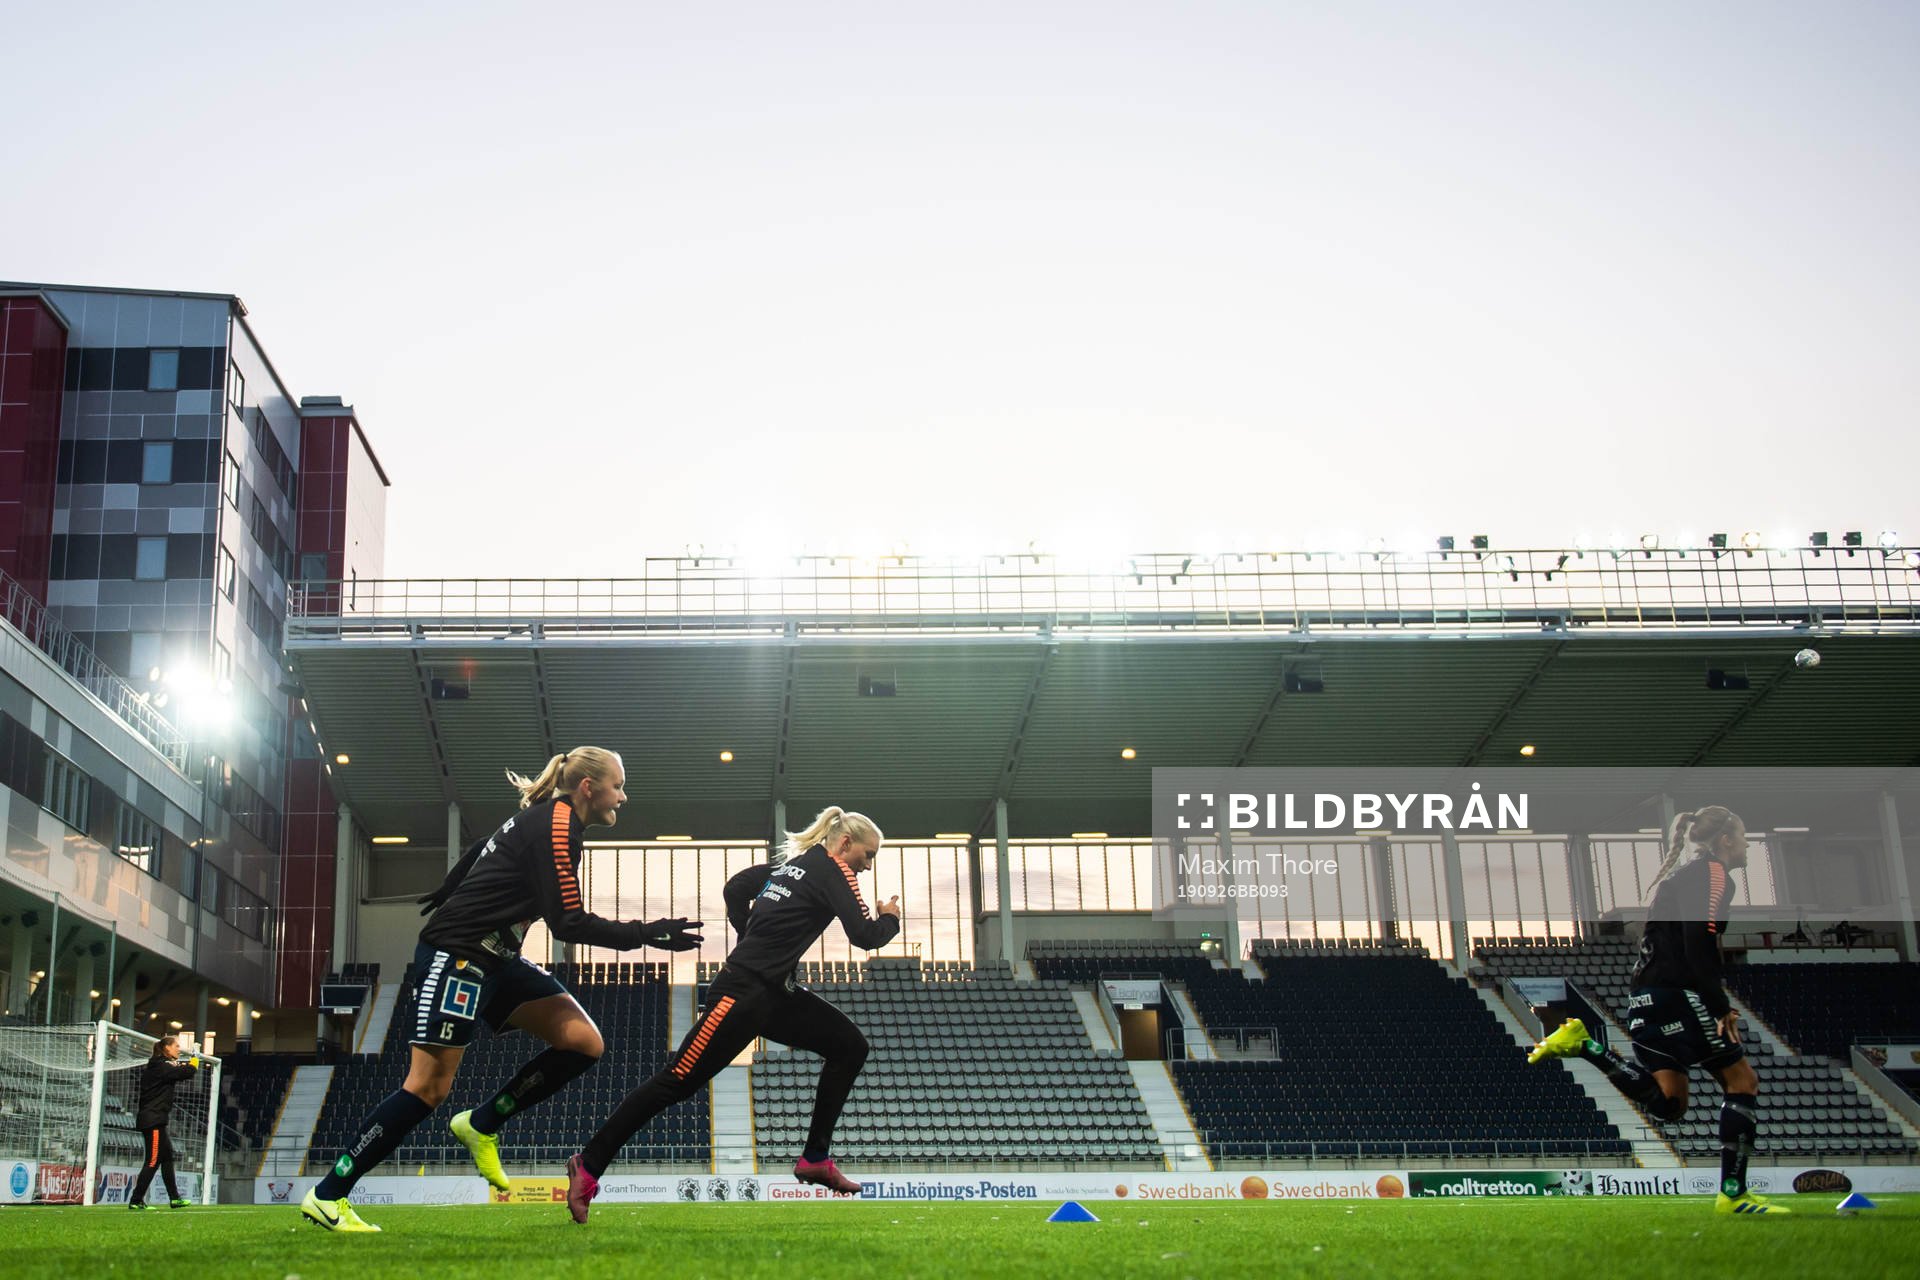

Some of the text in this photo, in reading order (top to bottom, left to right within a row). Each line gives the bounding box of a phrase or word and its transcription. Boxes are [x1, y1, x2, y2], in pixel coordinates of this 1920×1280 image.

[439, 1021, 455, 1040] 15
[349, 1122, 384, 1158] Lundbergs
[108, 1172, 123, 1187] INTER
[1441, 1178, 1536, 1195] nolltretton
[1597, 1174, 1680, 1195] Hamlet
[107, 1188, 122, 1202] SPORT
[604, 1184, 667, 1193] Grant Thornton
[772, 1189, 811, 1198] Grebo
[815, 1189, 828, 1198] El
[878, 1182, 1037, 1200] Linköpings-Posten
[1138, 1183, 1236, 1199] Swedbank
[1273, 1181, 1372, 1198] Swedbank
